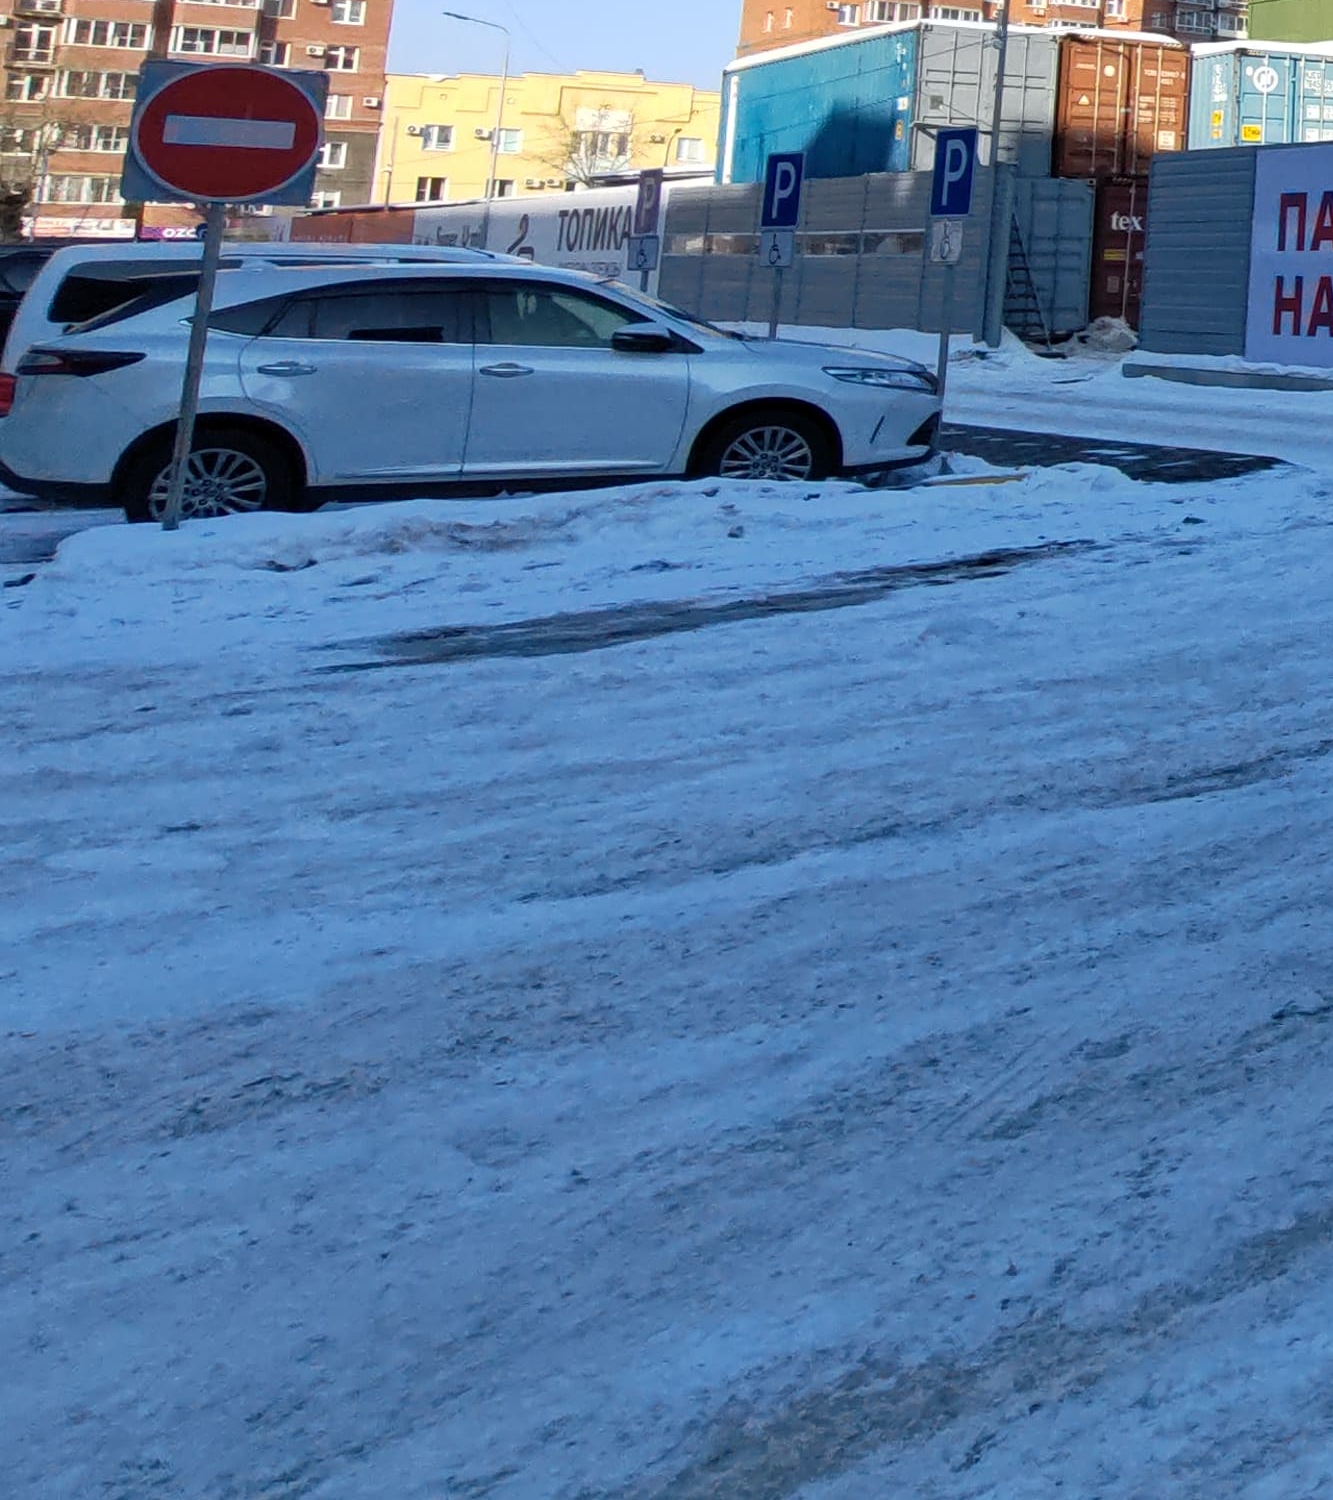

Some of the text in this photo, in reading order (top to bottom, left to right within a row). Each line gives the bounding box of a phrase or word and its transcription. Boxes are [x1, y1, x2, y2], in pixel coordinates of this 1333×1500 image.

[772, 162, 796, 219] P
[942, 139, 968, 206] P
[557, 205, 632, 252] ТОПИКА
[1110, 211, 1144, 231] tex
